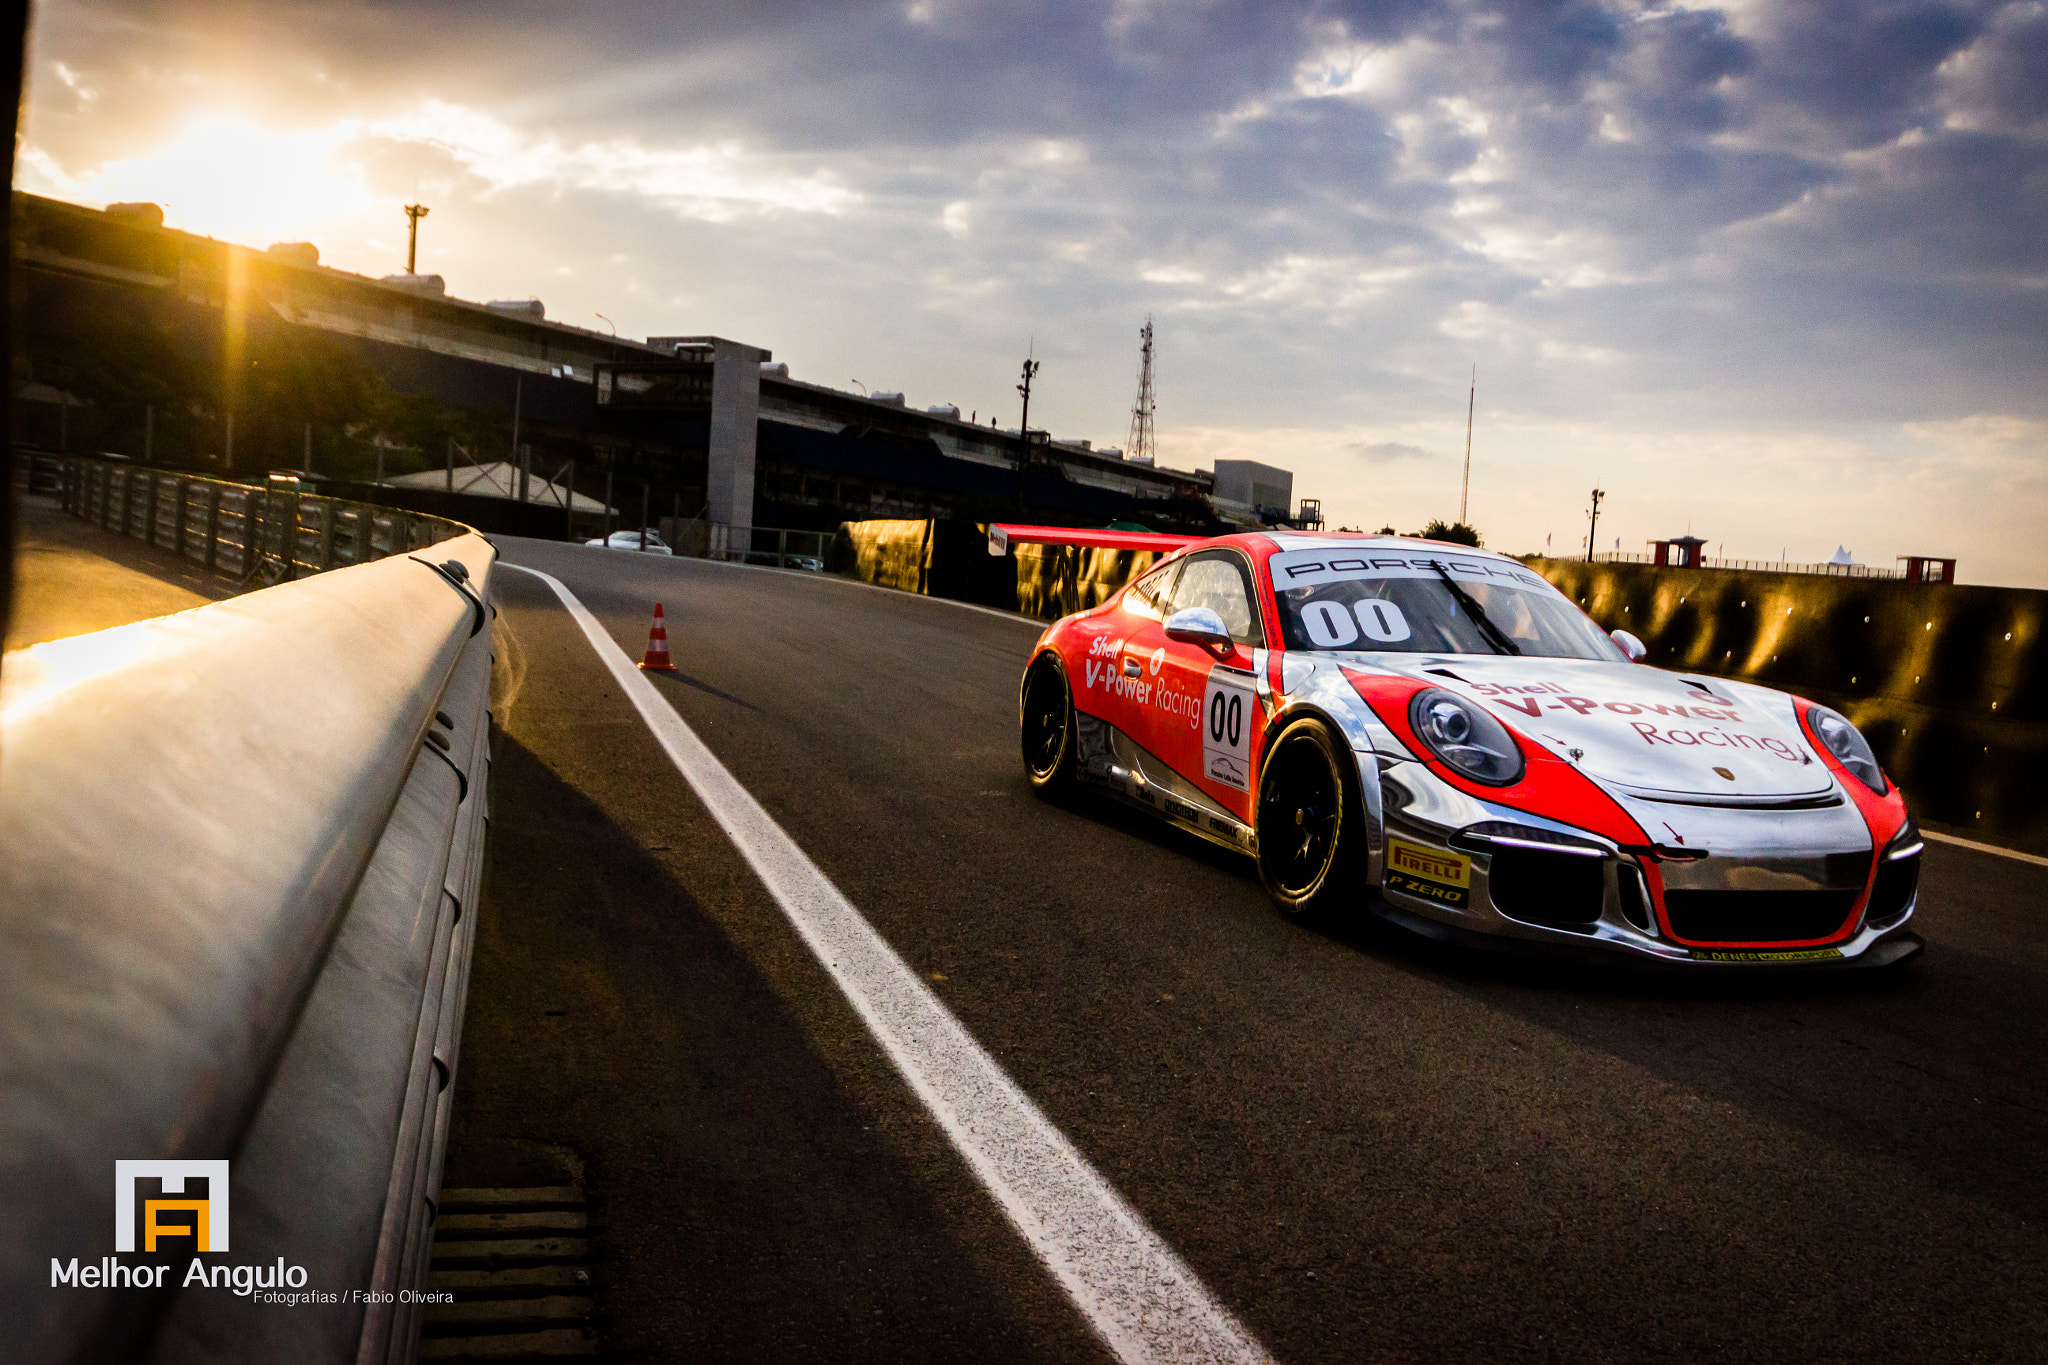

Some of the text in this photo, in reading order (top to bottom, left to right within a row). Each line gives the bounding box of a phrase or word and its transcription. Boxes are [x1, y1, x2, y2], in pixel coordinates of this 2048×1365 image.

[1285, 559, 1548, 589] PORSCHE
[1300, 599, 1411, 647] 00
[1089, 635, 1124, 659] Shell
[1085, 659, 1201, 729] V-Power Racing
[1470, 681, 1570, 695] Shell
[1210, 691, 1242, 747] 00
[1492, 697, 1744, 722] V-Power
[1629, 721, 1800, 761] Racing
[1394, 846, 1462, 880] PIRELLI
[1406, 880, 1462, 901] ZERO
[1711, 952, 1758, 961] DENER
